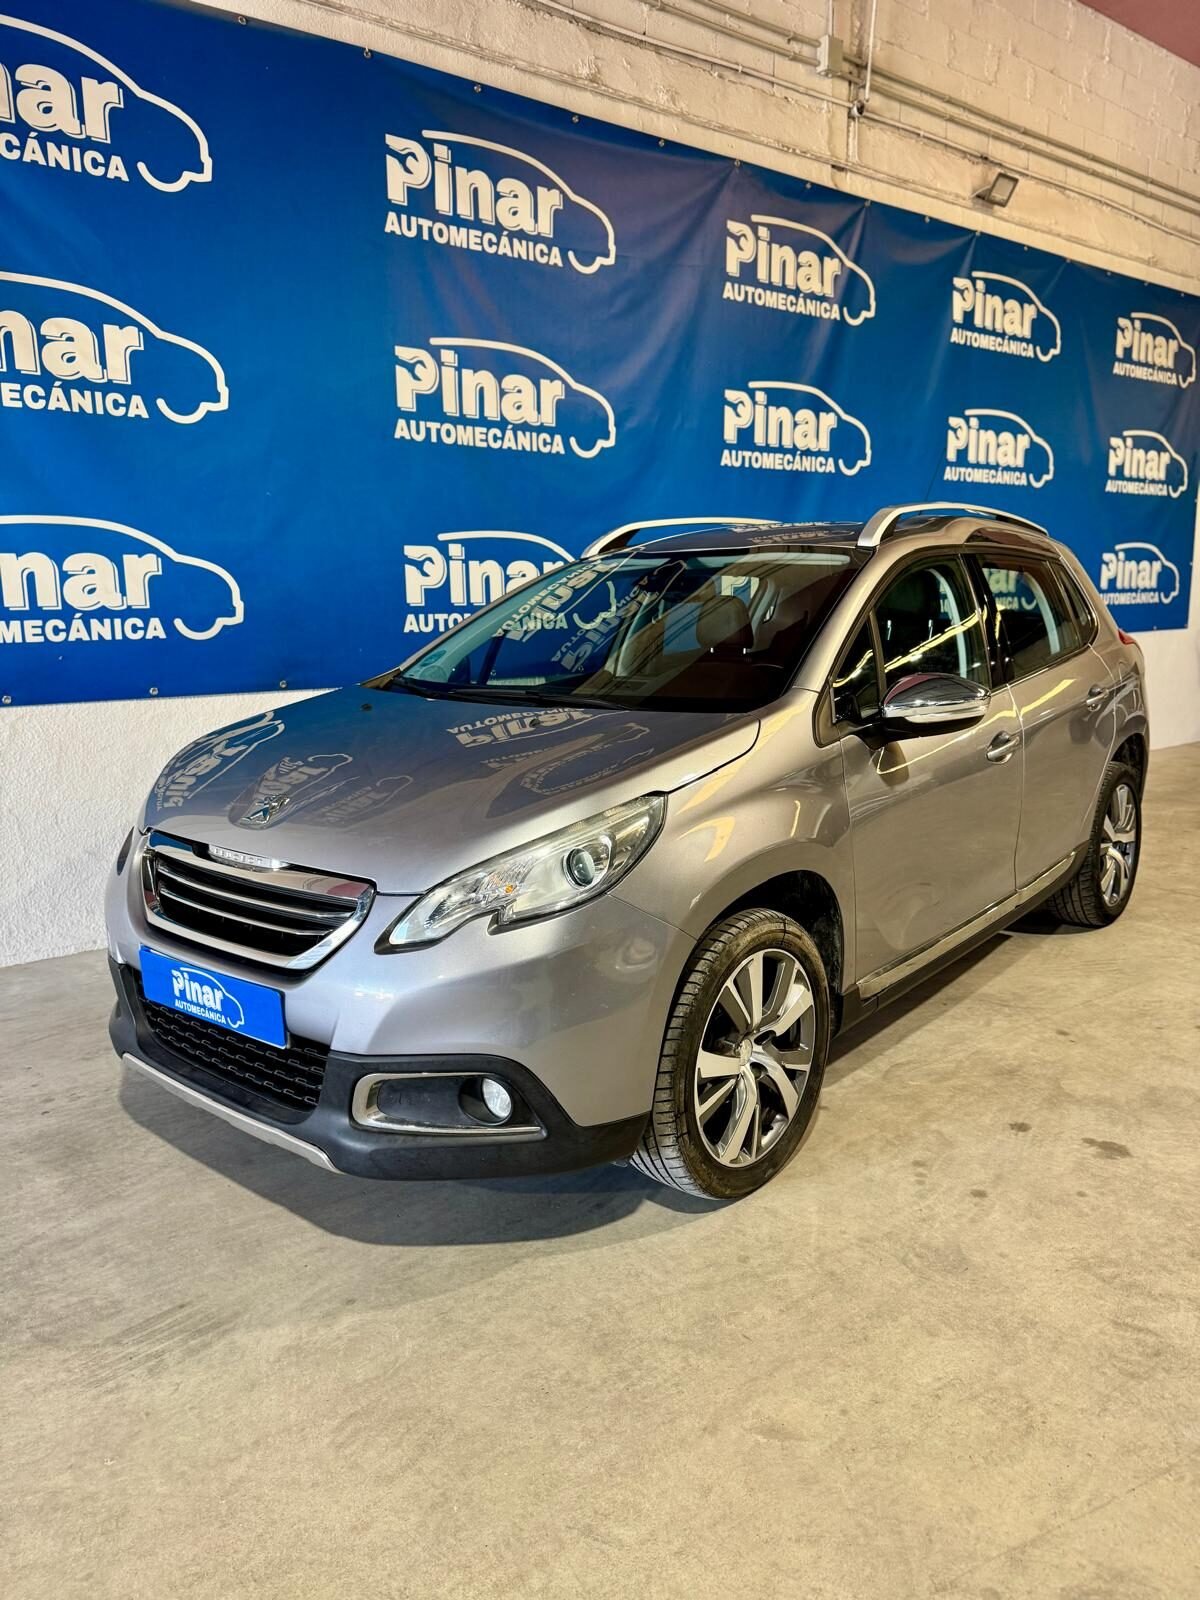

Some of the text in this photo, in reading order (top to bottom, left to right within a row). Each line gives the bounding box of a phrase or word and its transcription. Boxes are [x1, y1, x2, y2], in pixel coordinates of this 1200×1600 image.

[385, 133, 563, 238] Pinar
[384, 211, 564, 267] AUTOMECÁNICA
[726, 219, 842, 297] Pinar
[722, 281, 840, 321] AUTOMECÁNICA
[952, 276, 1037, 339] Pinar
[950, 327, 1035, 358] AUTOMECÁNICA
[1115, 316, 1179, 369] Pinar
[394, 345, 565, 427] Pinar
[1112, 361, 1177, 385] AUTOMECÁNICA
[0, 381, 149, 419] ECÁNICA
[723, 388, 838, 452] Pinar
[394, 418, 565, 455] AUTOMECÁNICA
[946, 416, 1031, 468] Pinar
[720, 449, 835, 473] AUTOMECÁNICA
[943, 466, 1028, 486] AUTOMECÁNICA
[1108, 436, 1171, 481] Pinar
[1100, 551, 1162, 590] Pinar
[0, 612, 167, 644] MECÁNICA
[171, 969, 224, 1012] Pinar
[175, 999, 227, 1025] AUTOMECÁNICA
